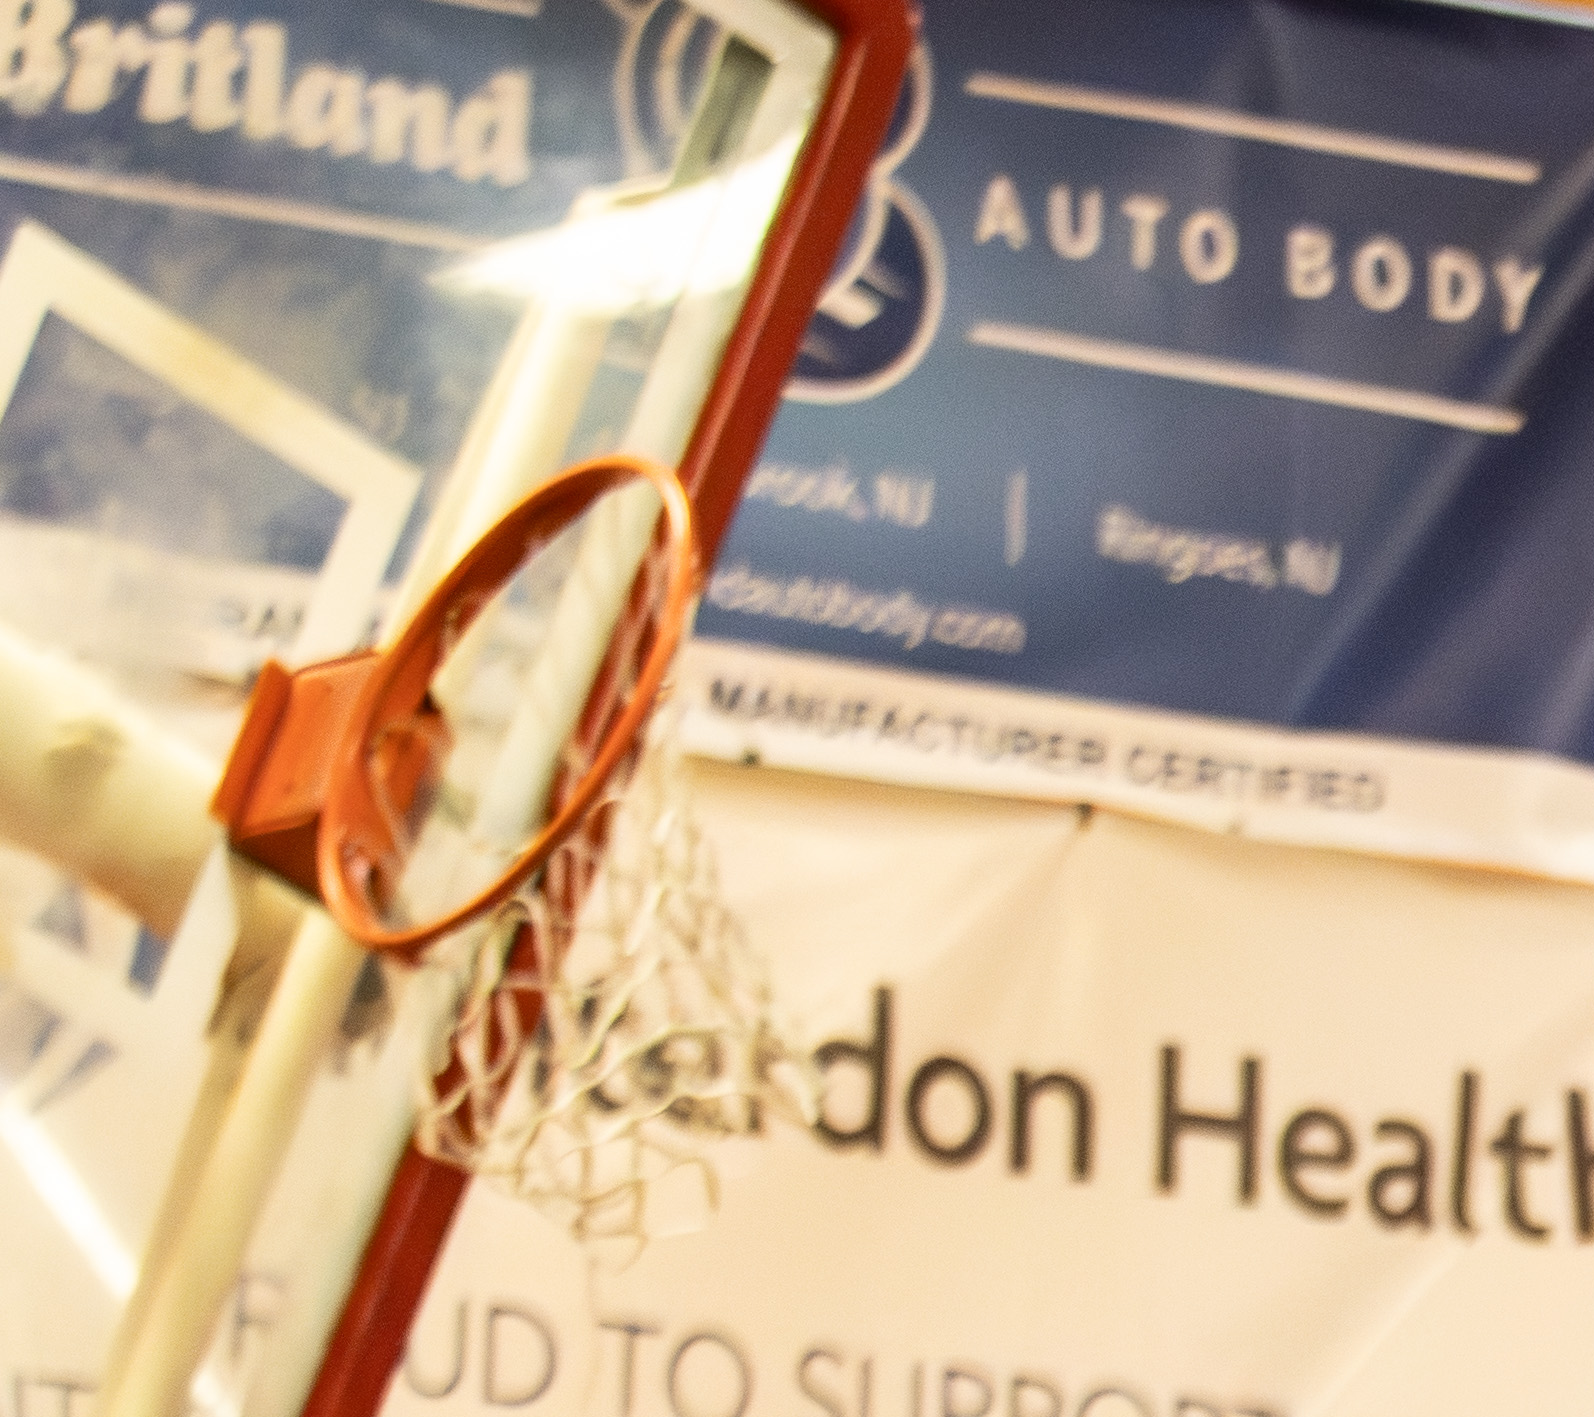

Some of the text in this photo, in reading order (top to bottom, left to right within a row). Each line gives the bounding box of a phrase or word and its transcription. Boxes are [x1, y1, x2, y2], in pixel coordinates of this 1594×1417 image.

[0, 0, 533, 187] Britland
[974, 174, 1545, 335] AUTO BODY
[705, 677, 1390, 815] MANUFACTURER CERTIFIED
